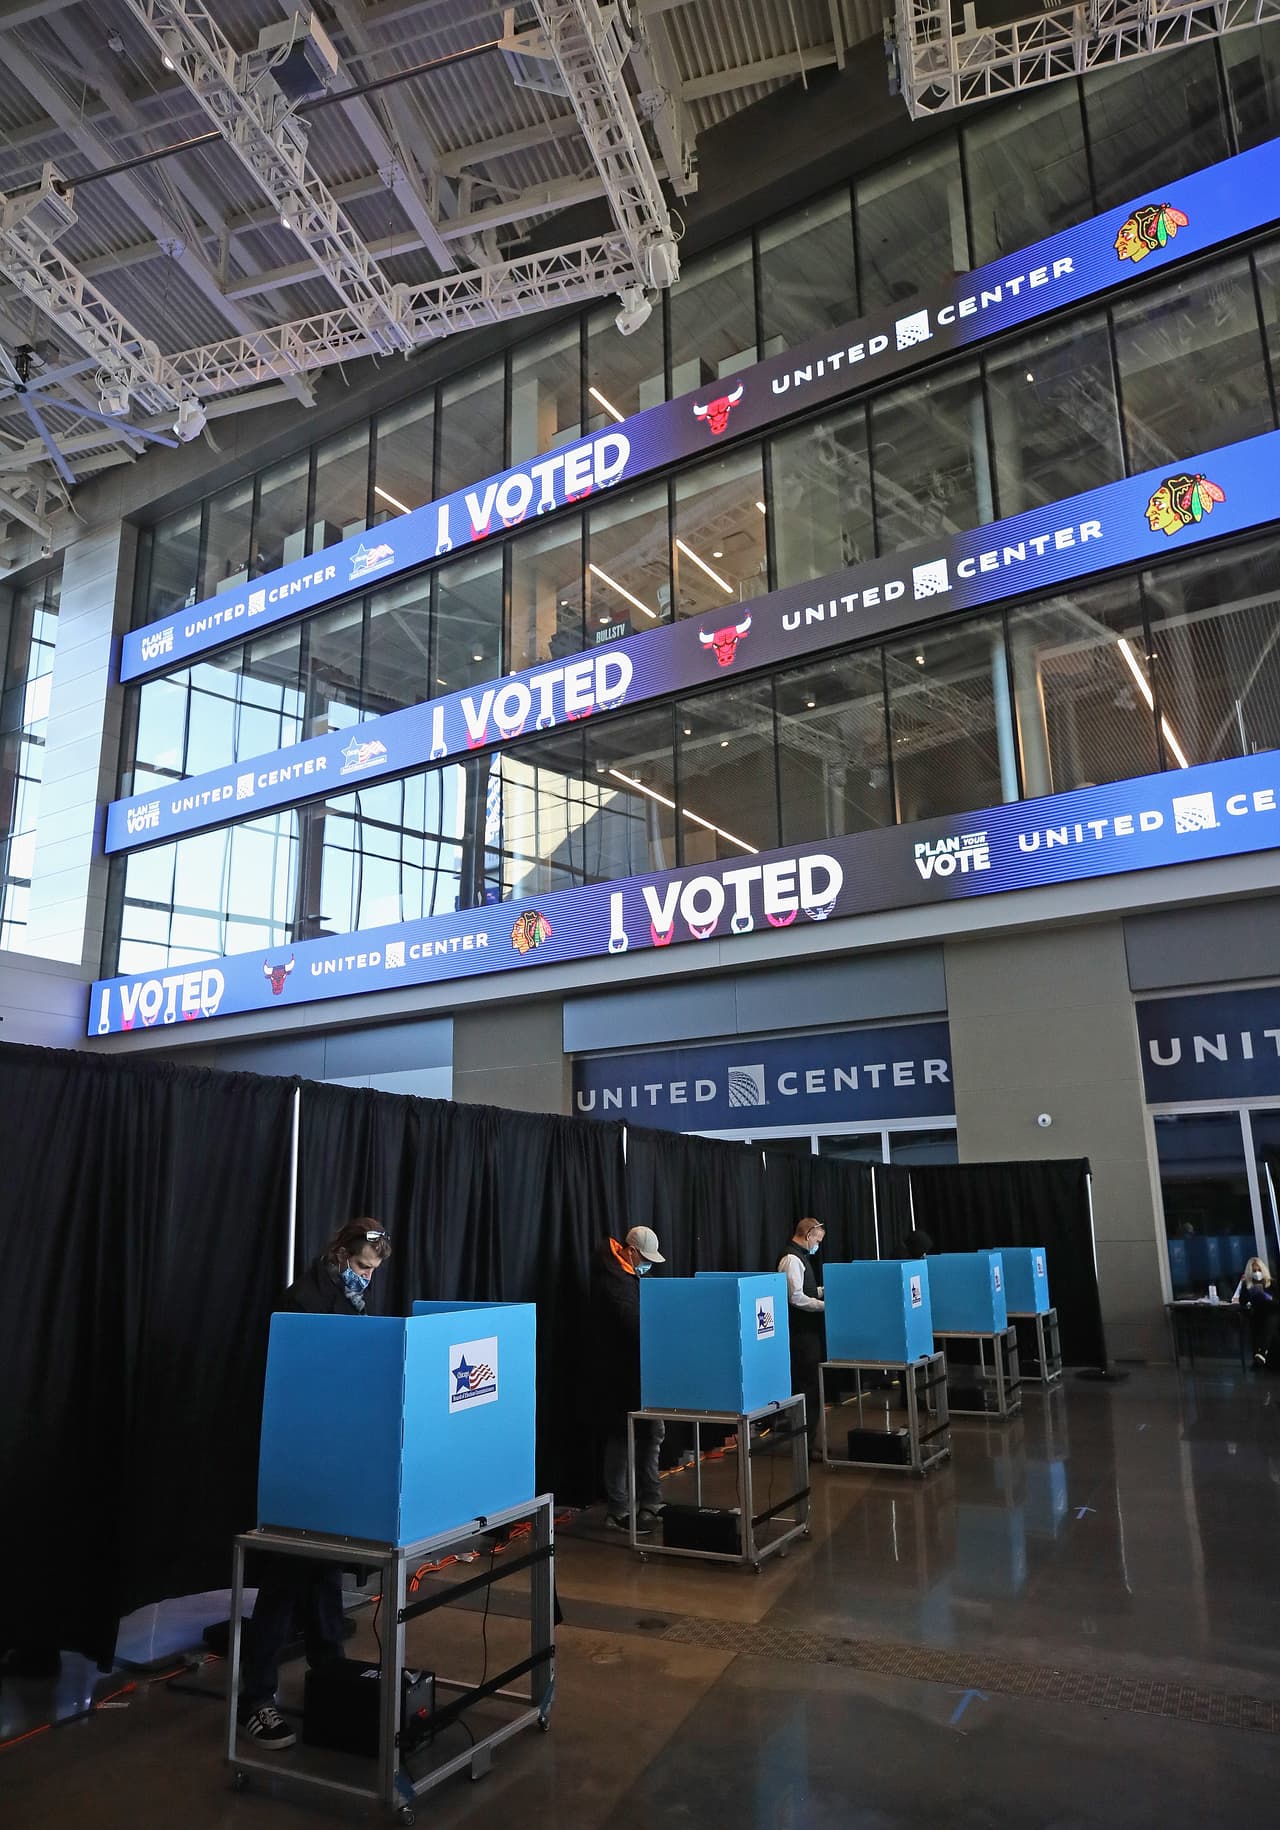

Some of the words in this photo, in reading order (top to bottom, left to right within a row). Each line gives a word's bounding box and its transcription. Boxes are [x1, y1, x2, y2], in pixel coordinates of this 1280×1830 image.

[772, 335, 888, 394] UNITED
[937, 257, 1075, 325] CENTER
[436, 504, 451, 550] I
[465, 433, 631, 532] VOTED
[185, 604, 245, 638] UNITED
[269, 565, 336, 603] CENTER
[782, 580, 905, 630] UNITED
[957, 520, 1103, 578] CENTER
[142, 632, 162, 648] PLAN
[142, 638, 173, 661] VOTE
[431, 706, 446, 753] I
[461, 652, 633, 740] VOTED
[128, 805, 148, 818] PLAN
[172, 785, 233, 814] UNITED
[258, 756, 327, 788] CENTER
[127, 812, 160, 834] VOTE
[914, 837, 960, 858] PLAN
[963, 836, 986, 846] YOUR
[1018, 811, 1164, 852] UNITED
[1226, 789, 1277, 816] CE
[915, 847, 991, 880] VOTE
[609, 892, 627, 946] I
[642, 854, 843, 933] VOTED
[311, 952, 381, 976] UNITED
[409, 932, 489, 959] CENTER
[99, 989, 110, 1029] I
[120, 968, 225, 1021] VOTED
[577, 1079, 717, 1112] UNITED
[777, 1058, 951, 1096] CENTER
